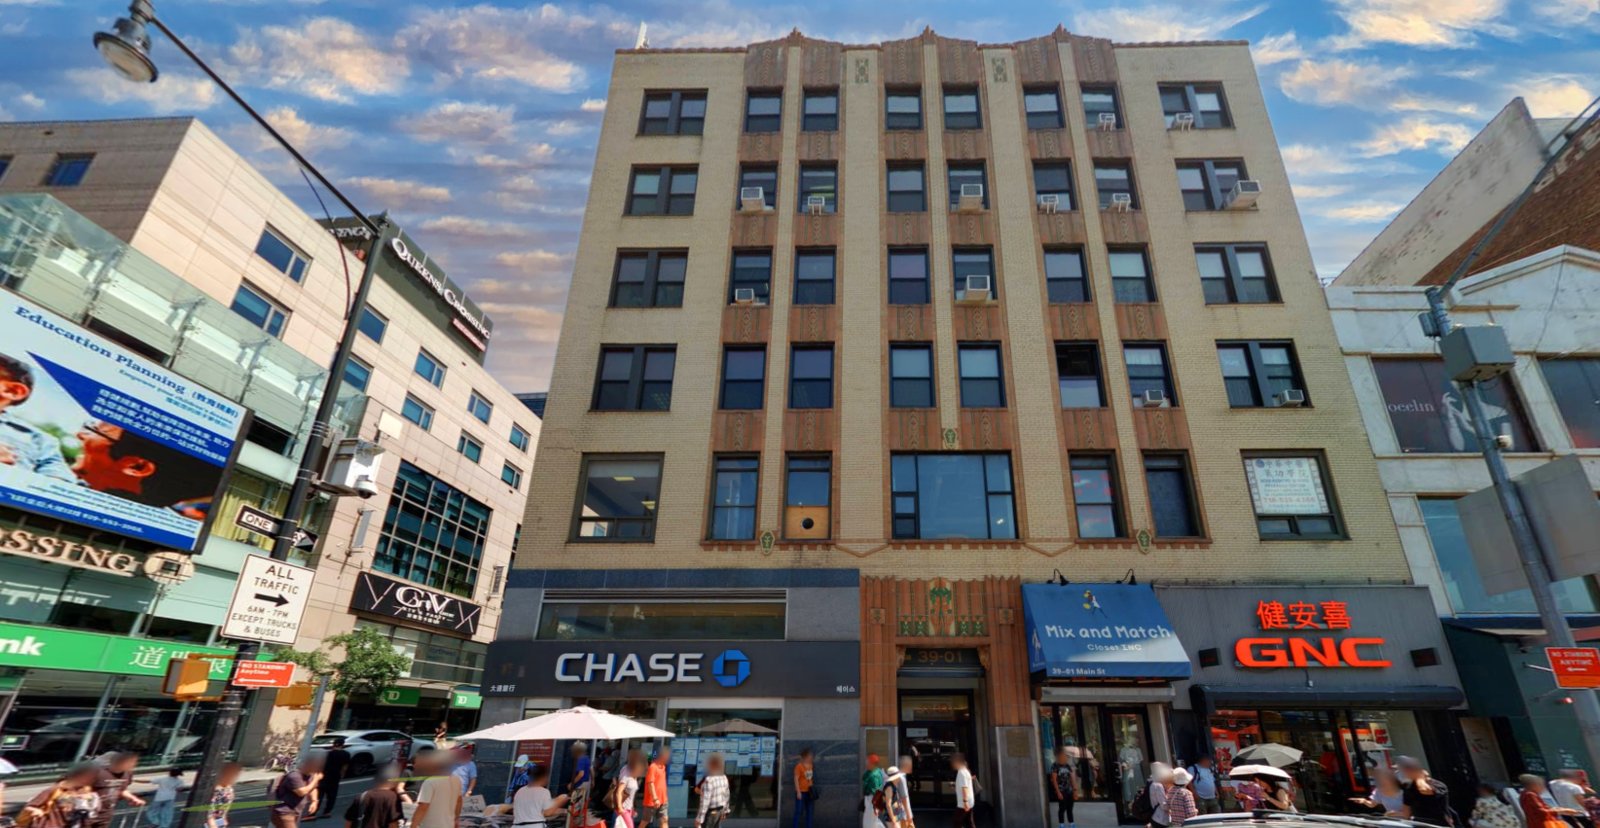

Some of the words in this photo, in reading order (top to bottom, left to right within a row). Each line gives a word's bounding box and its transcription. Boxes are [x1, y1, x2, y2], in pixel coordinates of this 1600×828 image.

[391, 237, 445, 296] QUEENS
[15, 306, 112, 358] Education
[116, 354, 186, 395] Planning
[245, 513, 271, 530] ONE
[0, 527, 142, 573] SSING
[265, 565, 295, 581] ALL
[254, 577, 299, 595] TRAFFIC
[247, 605, 265, 613] 6AM
[272, 609, 289, 618] 7PM
[1257, 601, 1352, 630] 健安喜
[231, 612, 263, 624] EXCEPT
[267, 618, 297, 630] TRUCKS
[243, 625, 251, 633] &
[254, 626, 281, 638] BUSES
[1045, 625, 1075, 638] Mix
[1079, 626, 1112, 638] and
[1114, 624, 1171, 639] Match
[917, 650, 963, 663] 39-01
[1235, 637, 1392, 668] GNC
[555, 653, 704, 683] CHASE
[1076, 667, 1096, 675] Main
[1097, 667, 1106, 675] St
